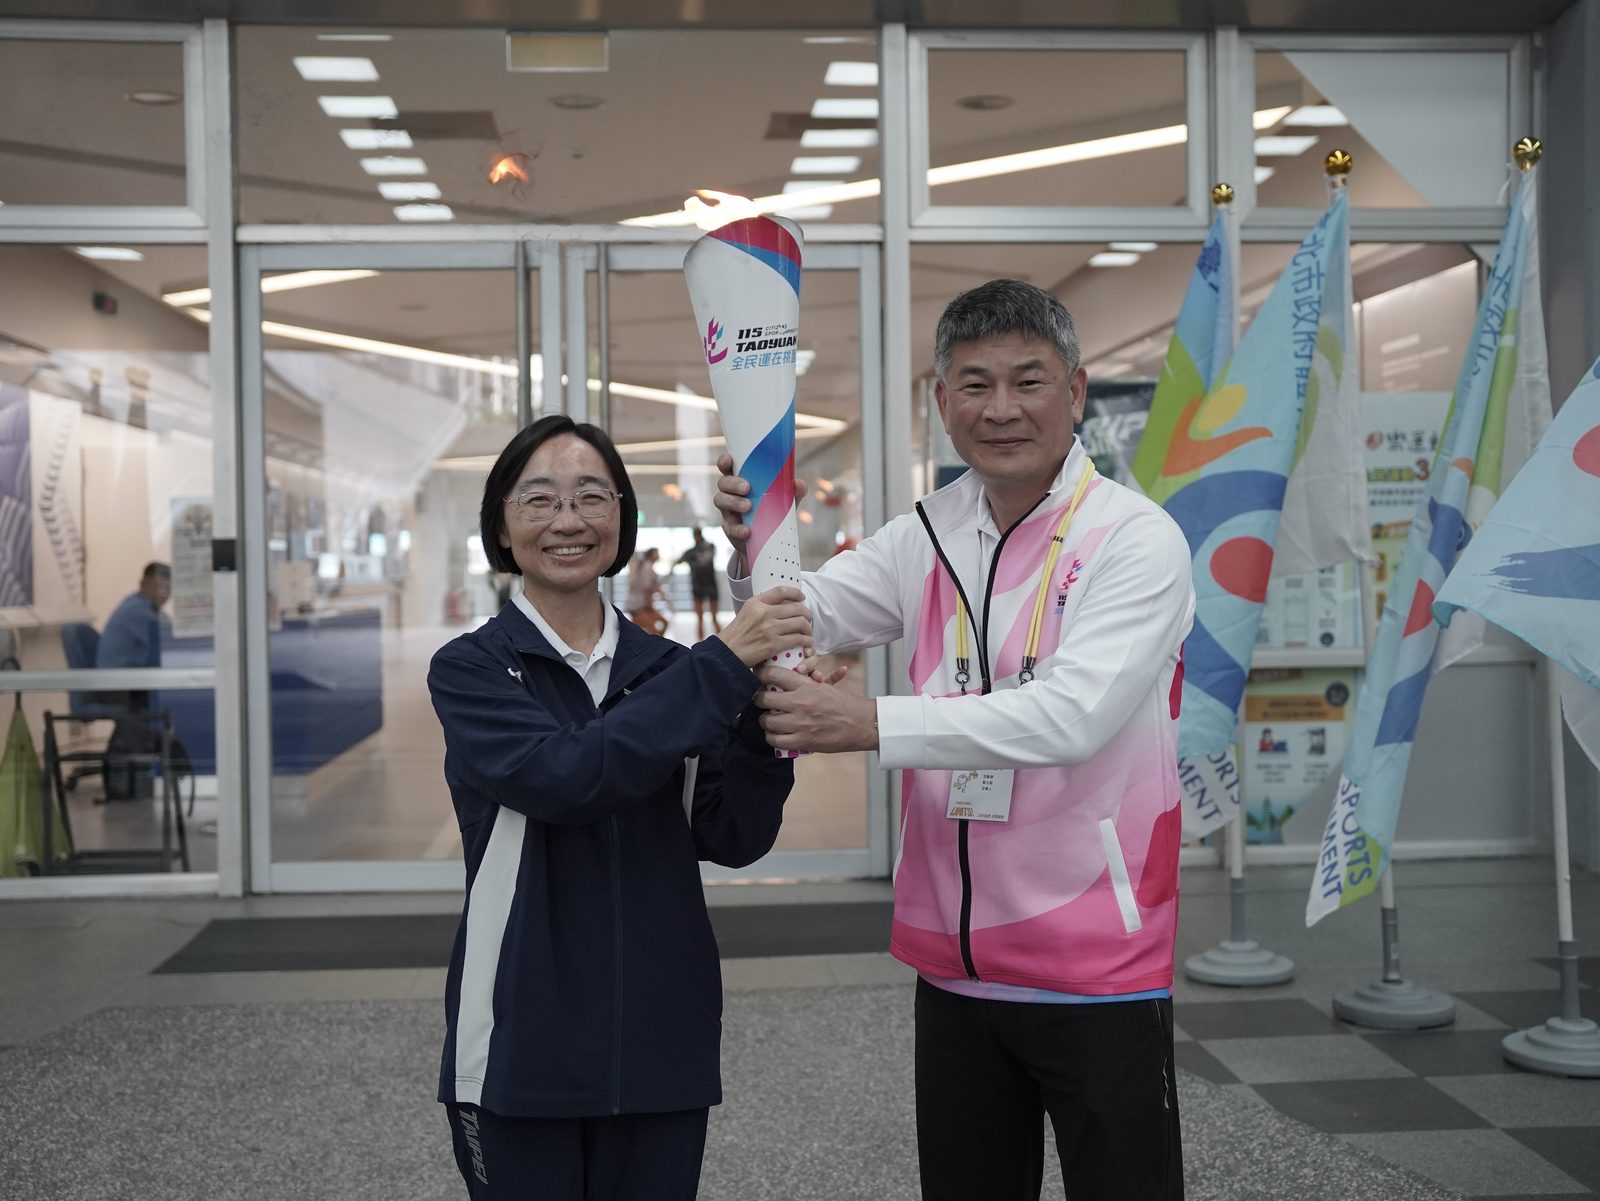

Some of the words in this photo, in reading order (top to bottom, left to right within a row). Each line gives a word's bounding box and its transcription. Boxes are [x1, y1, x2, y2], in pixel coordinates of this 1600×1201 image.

[738, 327, 763, 339] 115
[1178, 757, 1223, 820] MENT
[1341, 780, 1373, 886] SPORTS
[459, 1110, 488, 1185] TAIPEI
